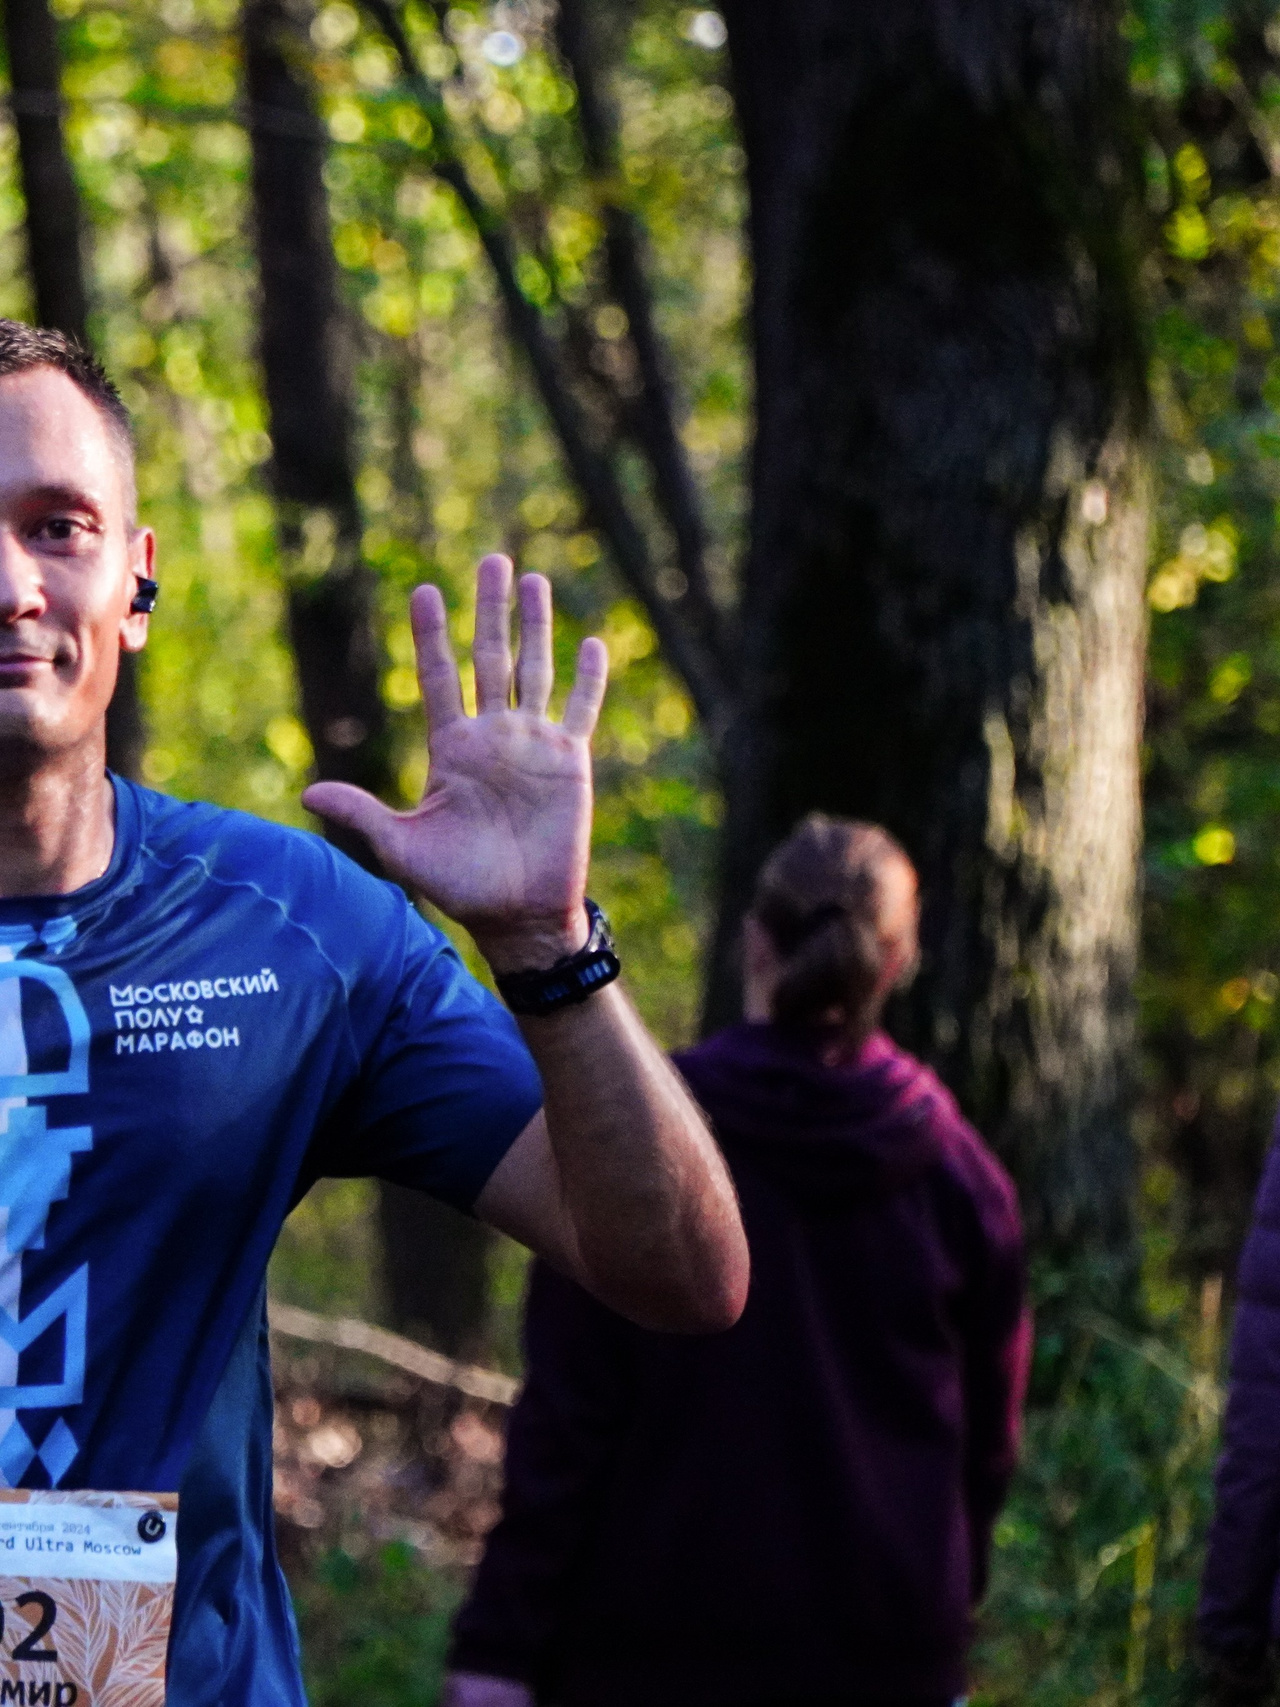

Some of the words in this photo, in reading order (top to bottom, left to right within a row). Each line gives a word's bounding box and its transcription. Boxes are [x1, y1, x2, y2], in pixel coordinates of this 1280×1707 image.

[109, 967, 280, 1007] МОСКОВСКИЙ
[114, 1006, 184, 1030] ПОЛУ
[116, 1026, 241, 1056] МАРАФОН
[61, 1521, 91, 1535] 2024
[24, 1537, 74, 1553] Ultra
[83, 1540, 142, 1556] Moscow
